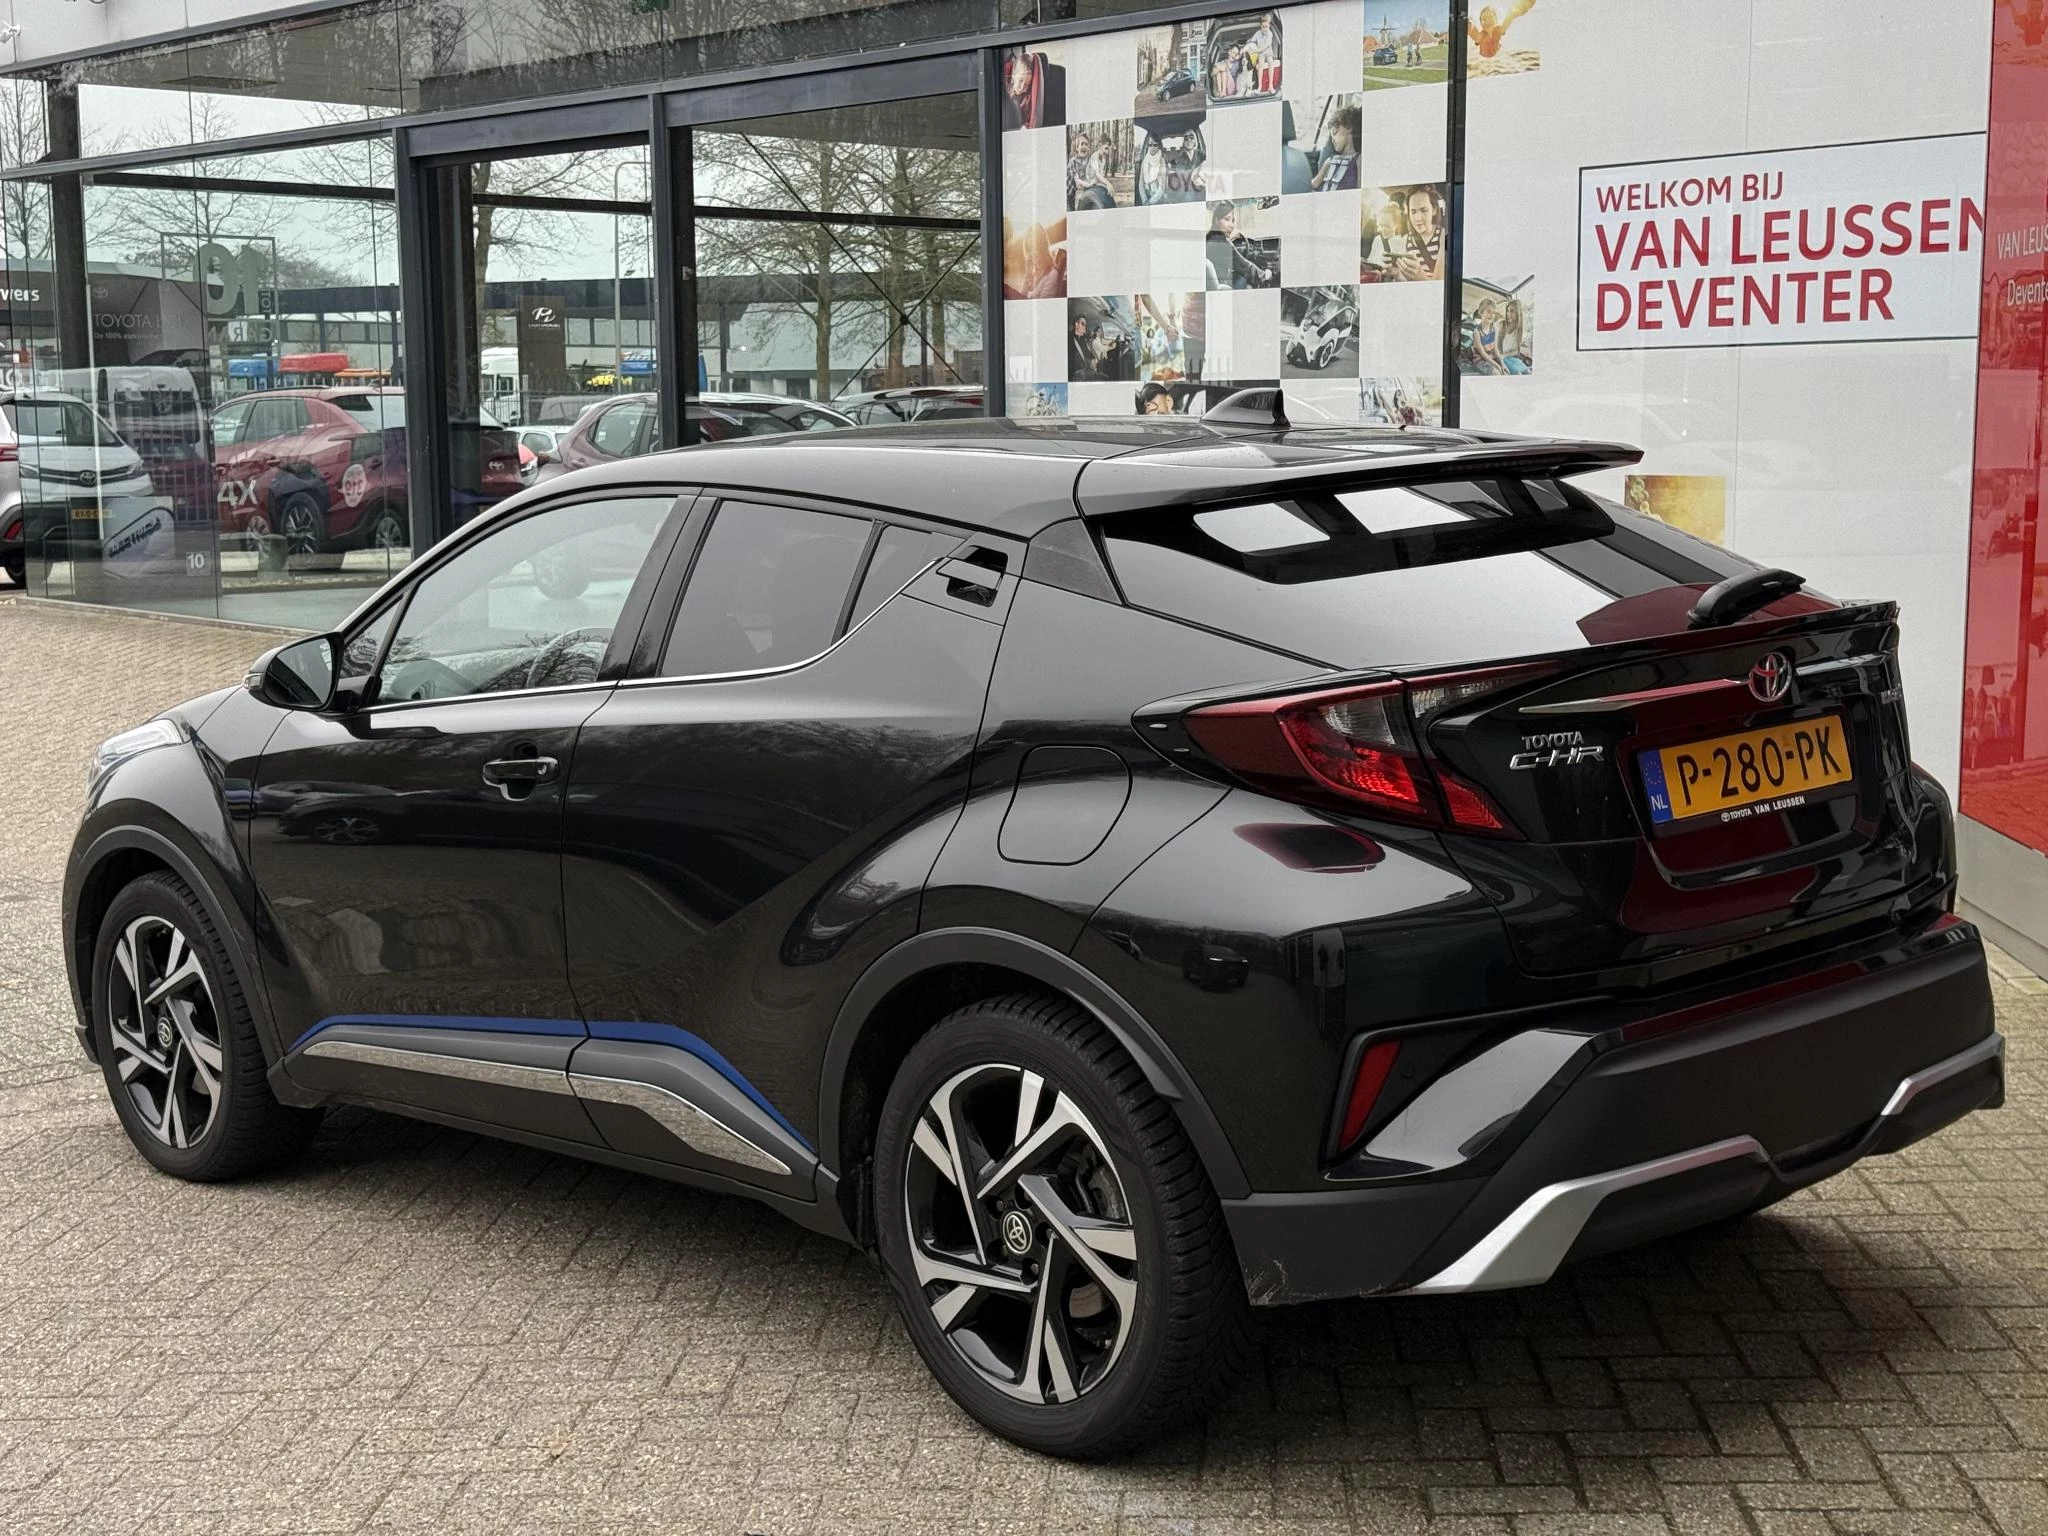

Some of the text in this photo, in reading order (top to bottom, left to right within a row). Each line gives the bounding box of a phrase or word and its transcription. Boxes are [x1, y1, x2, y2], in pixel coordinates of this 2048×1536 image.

[1596, 171, 1784, 213] WELKOM BIJ
[1594, 196, 1984, 273] VAN LEUSSEN
[1997, 230, 2021, 260] VAN
[1596, 268, 1894, 332] DEVENTER
[93, 313, 154, 328] TOYOTA
[188, 553, 205, 569] 10
[1521, 731, 1584, 750] TOYOTA
[1509, 746, 1605, 770] C-HR
[1676, 726, 1842, 806] P-280-PK
[1650, 793, 1668, 811] NL
[1729, 796, 1806, 820] TOYOTA VAN LEUSSEN
